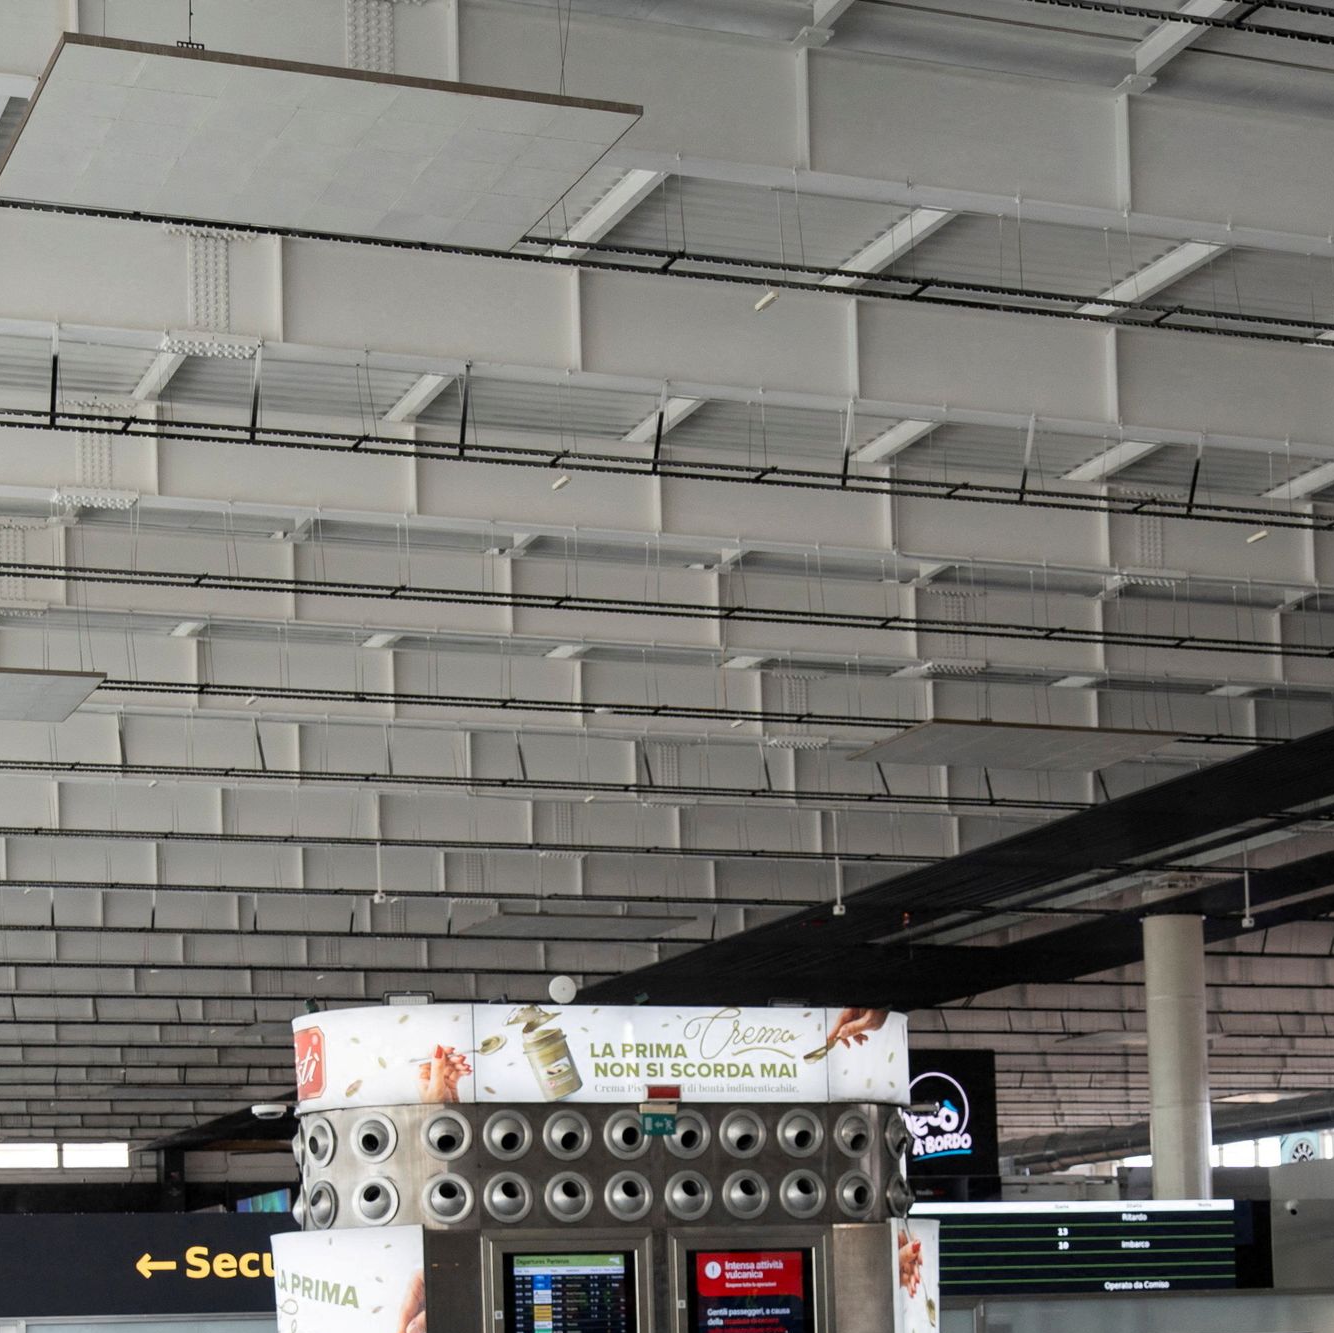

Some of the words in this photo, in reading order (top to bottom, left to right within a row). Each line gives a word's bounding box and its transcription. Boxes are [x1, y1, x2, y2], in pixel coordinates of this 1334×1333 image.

[590, 1043, 615, 1058] LA
[621, 1043, 688, 1058] PRIMA
[594, 1063, 640, 1078] NON
[646, 1063, 664, 1078] SI
[670, 1063, 754, 1078] SCORDA
[760, 1063, 798, 1078] MAI
[594, 1084, 625, 1093] Crema
[688, 1084, 696, 1093] di
[925, 1133, 972, 1154] BORDO
[725, 1261, 755, 1270] Intensa
[756, 1260, 783, 1270] attività
[725, 1271, 763, 1279] vulcanica
[1104, 1281, 1133, 1290] Operato
[1134, 1281, 1143, 1289] da
[291, 1273, 359, 1309] PRIMA
[707, 1308, 727, 1316] Gentili
[707, 1318, 723, 1326] della
